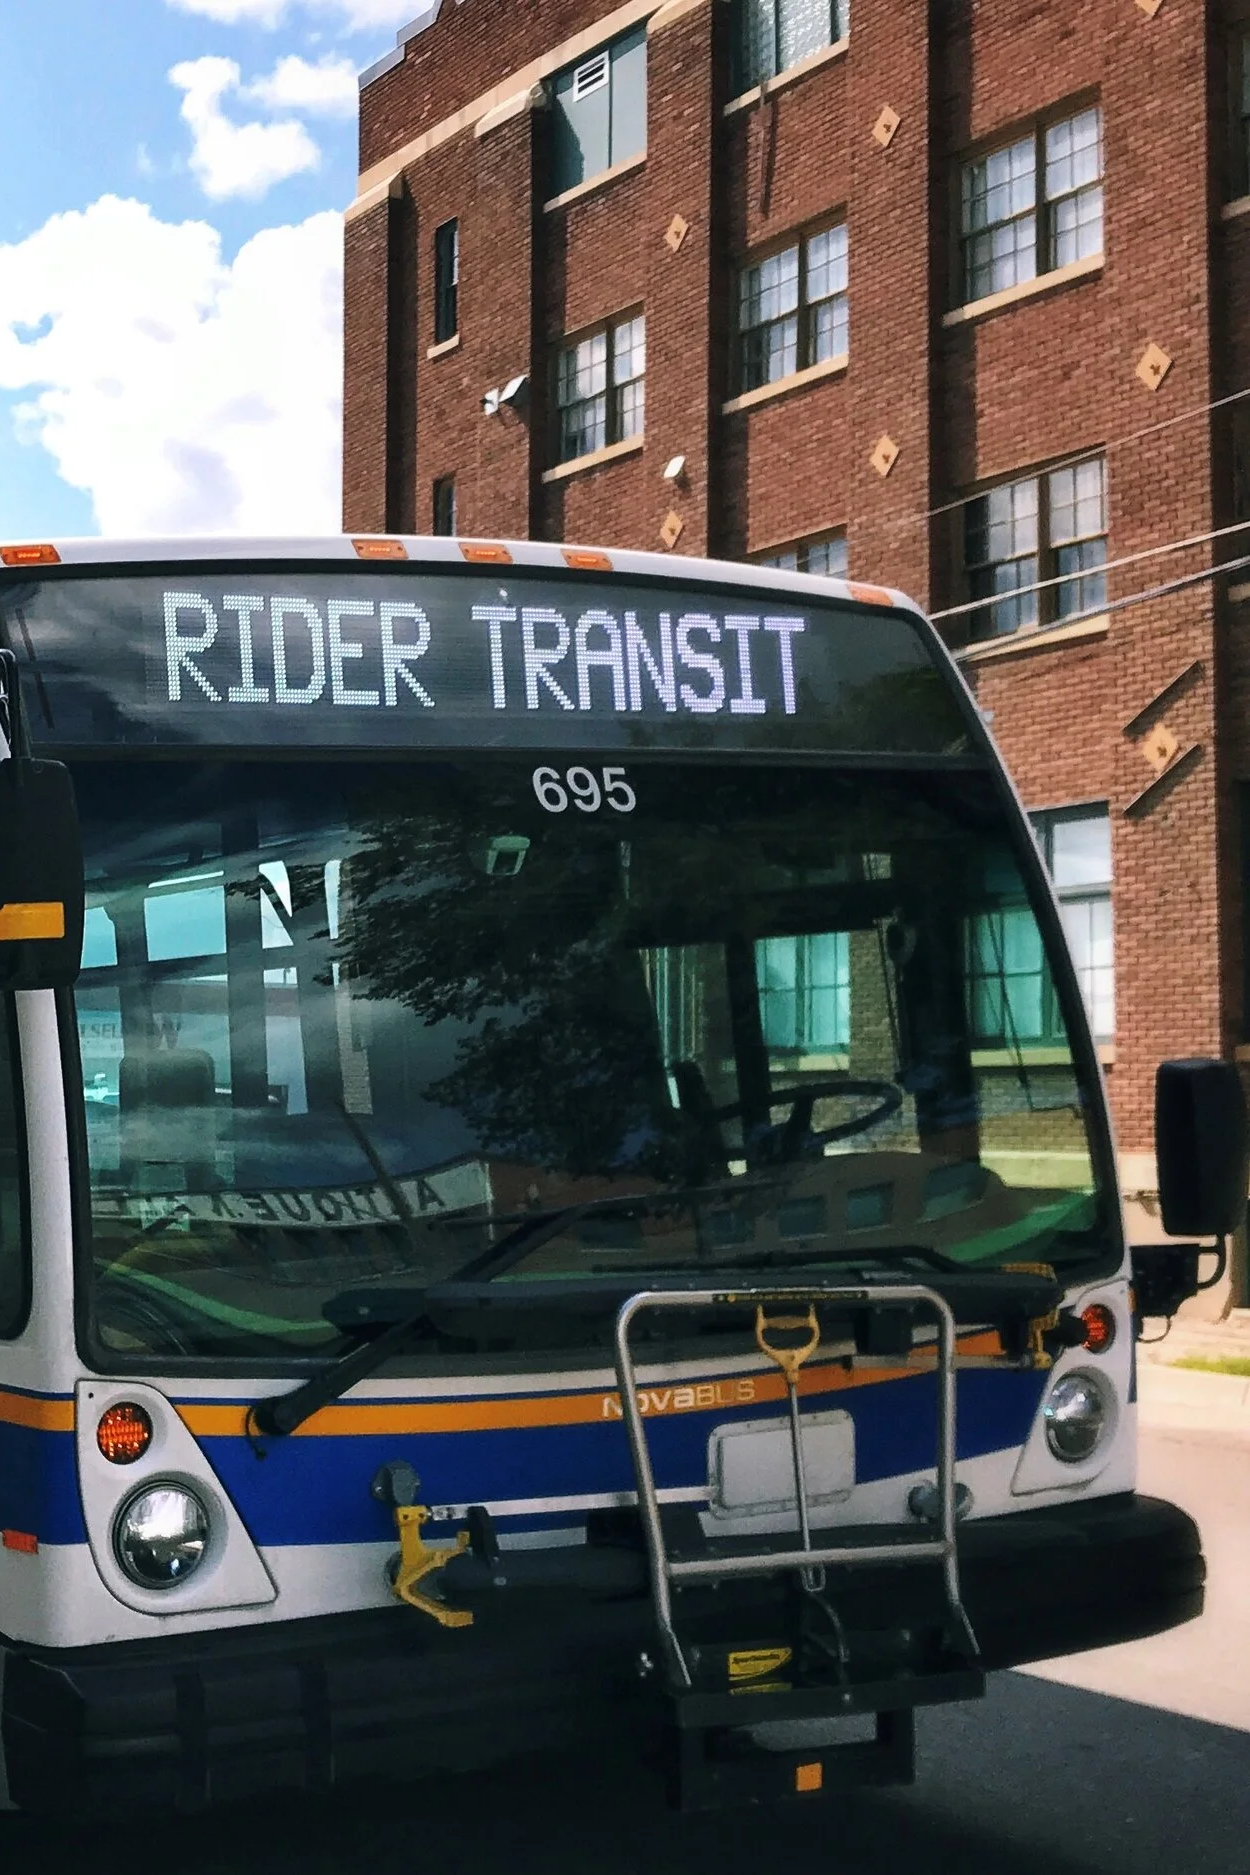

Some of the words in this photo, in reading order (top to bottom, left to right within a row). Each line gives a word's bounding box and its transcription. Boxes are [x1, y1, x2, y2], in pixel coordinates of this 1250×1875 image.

[163, 592, 435, 707] RIDER
[471, 605, 806, 715] TRANSIT
[532, 766, 637, 814] 695
